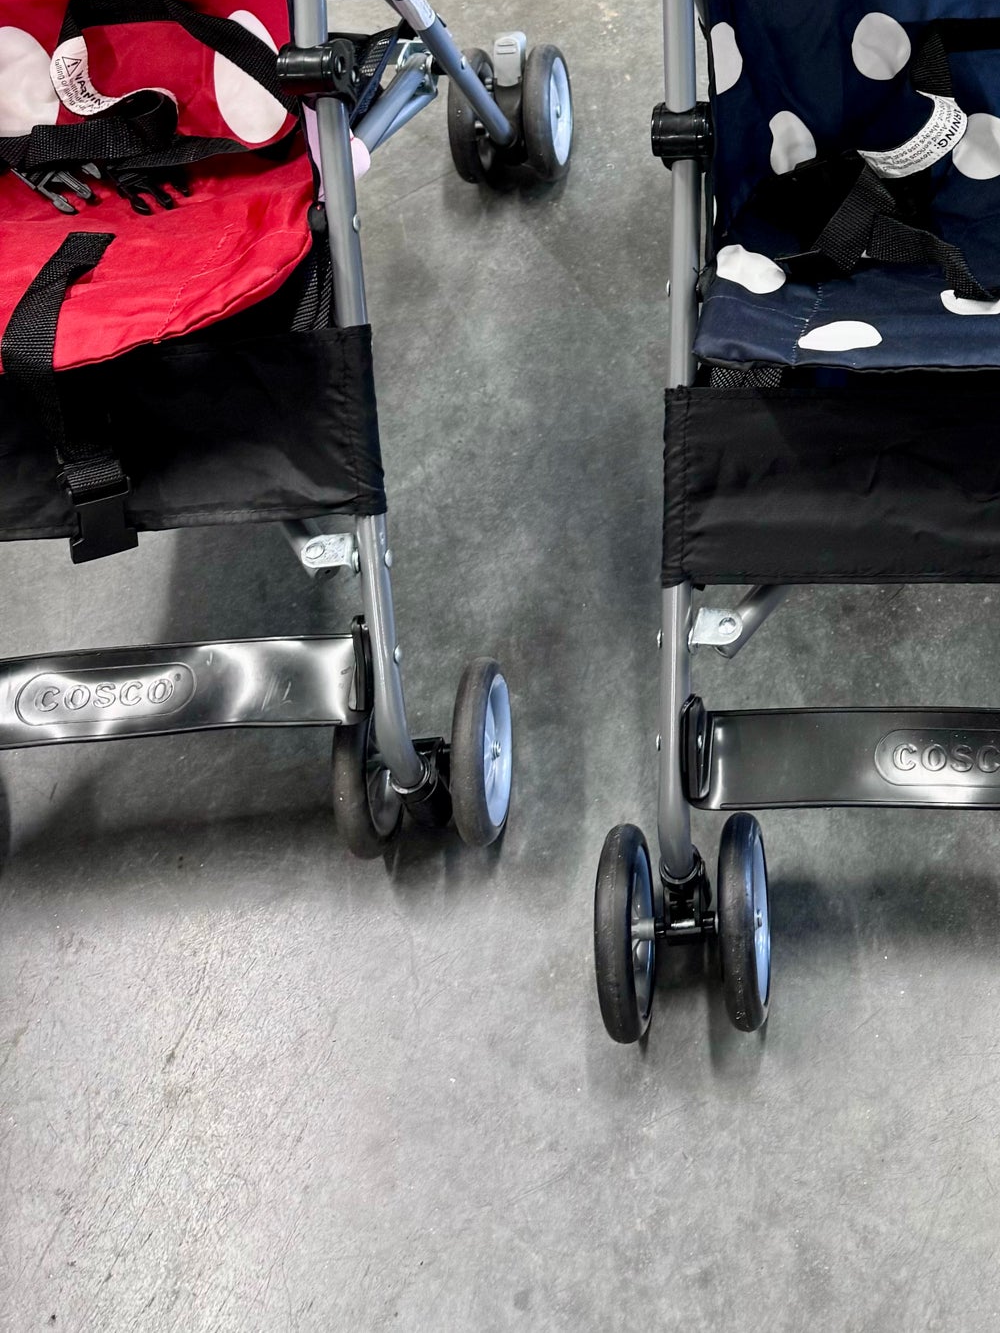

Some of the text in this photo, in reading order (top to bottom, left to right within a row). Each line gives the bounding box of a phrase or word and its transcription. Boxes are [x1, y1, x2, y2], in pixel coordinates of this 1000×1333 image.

[75, 70, 105, 106] WARNIN
[918, 122, 940, 145] Always
[933, 108, 962, 150] ARNING:
[906, 143, 921, 154] use
[909, 141, 932, 160] serious
[34, 678, 175, 713] COSCO
